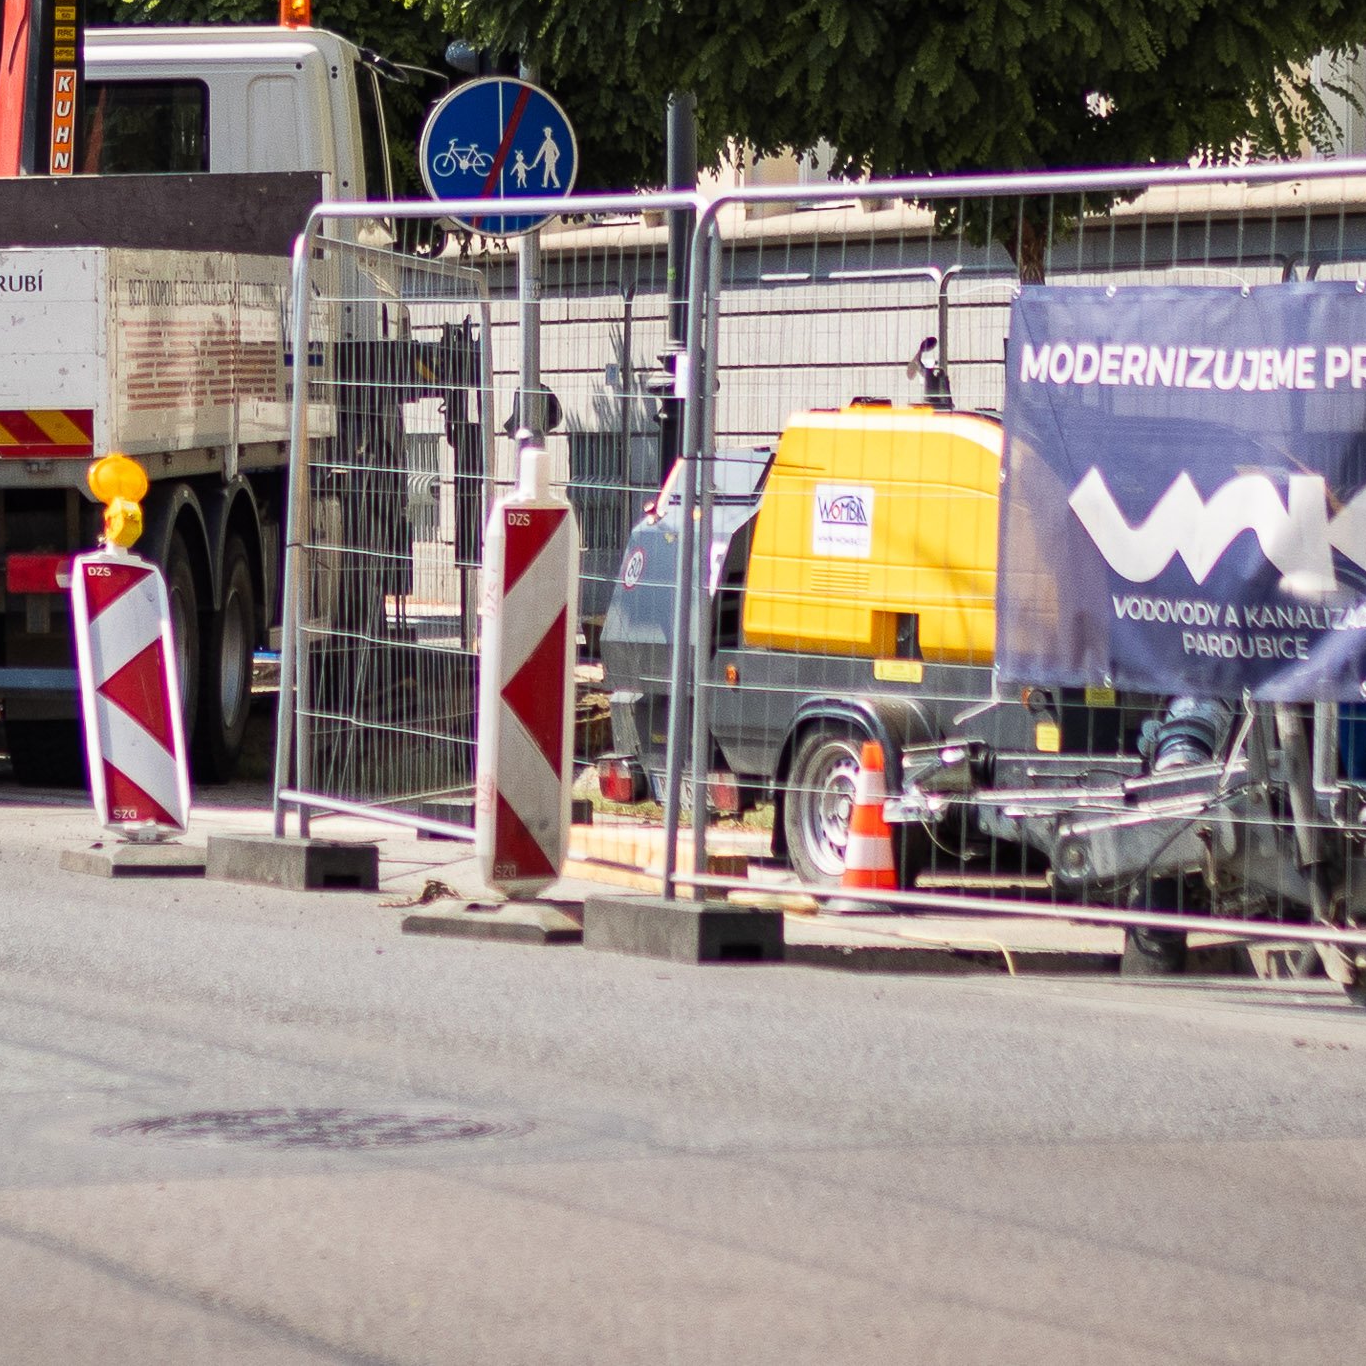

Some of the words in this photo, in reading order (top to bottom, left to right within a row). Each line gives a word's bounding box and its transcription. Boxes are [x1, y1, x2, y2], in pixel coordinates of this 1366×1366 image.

[54, 76, 72, 169] KUHN
[1020, 342, 1316, 391] MODERNIZUJEME
[508, 513, 530, 526] DZS
[818, 495, 866, 524] WOMBAT
[87, 566, 111, 577] DZS
[1112, 595, 1220, 628] VODOVODY
[1224, 606, 1241, 628] A
[1182, 631, 1310, 660] PARDUBICE
